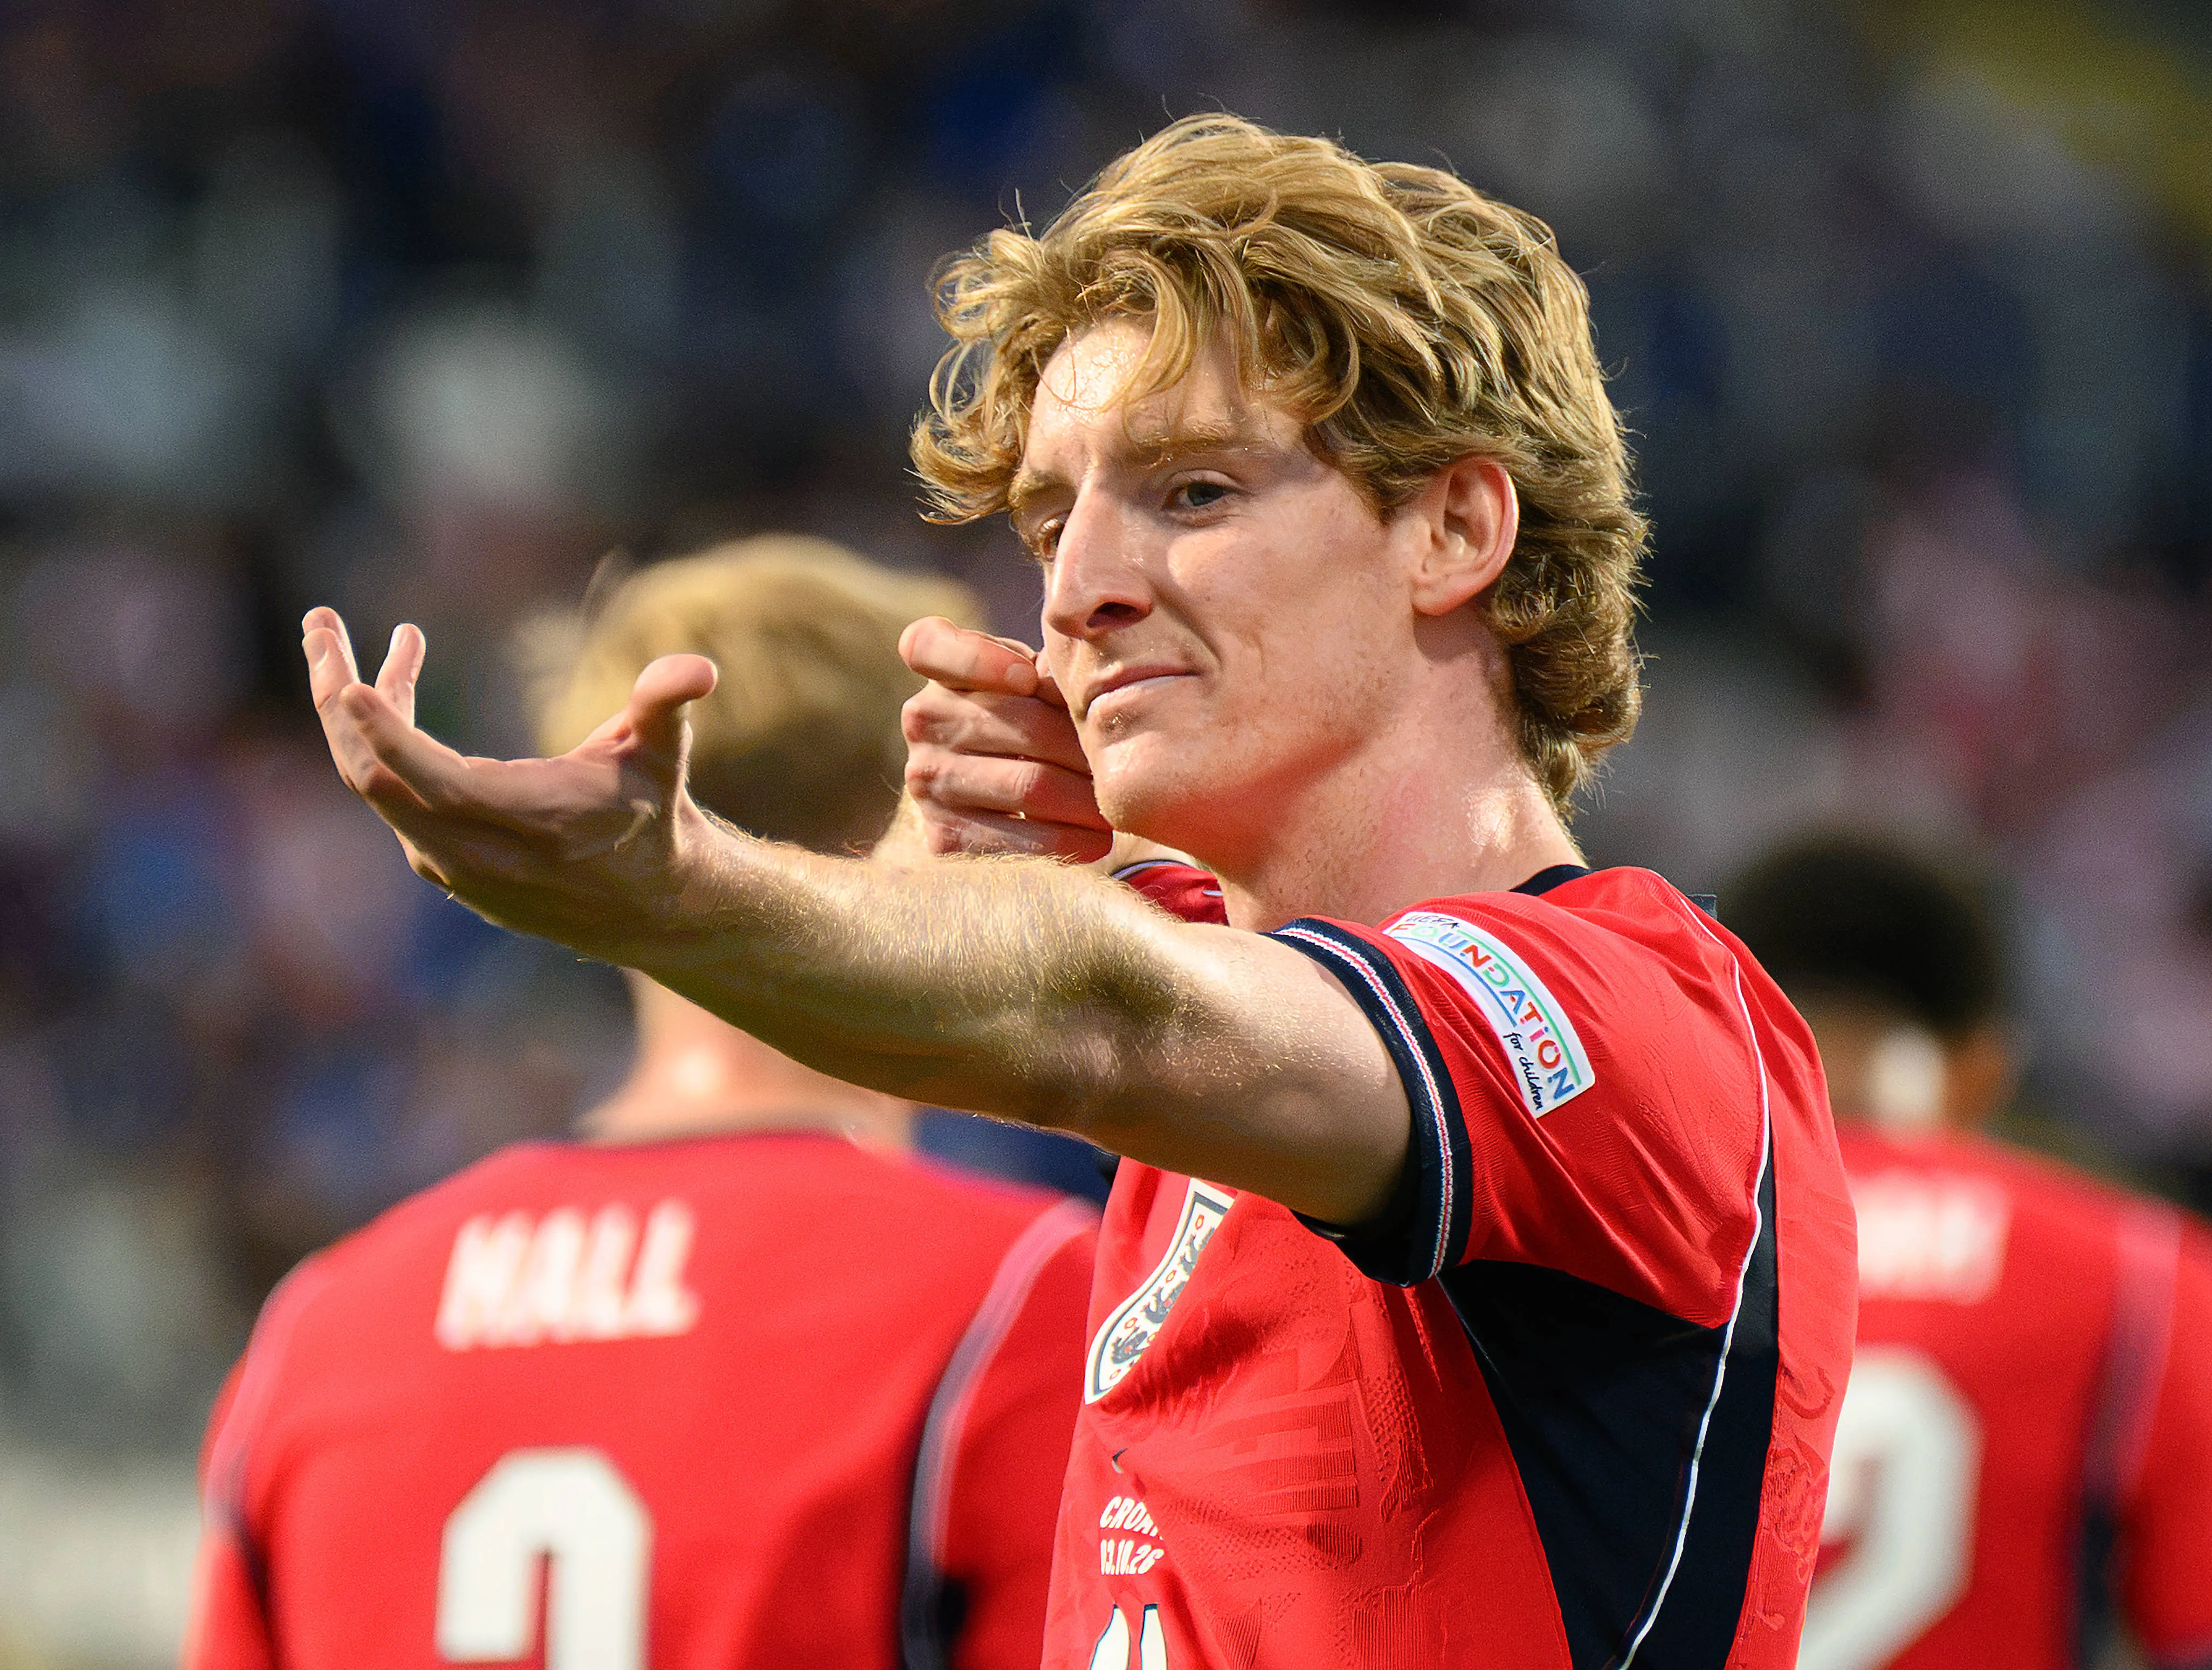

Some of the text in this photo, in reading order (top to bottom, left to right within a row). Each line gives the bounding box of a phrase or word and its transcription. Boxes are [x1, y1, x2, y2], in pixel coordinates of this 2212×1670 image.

[1387, 923, 1575, 1101] FOUNDATION
[1503, 1032, 1544, 1111] for children
[433, 1198, 701, 1352] HALL
